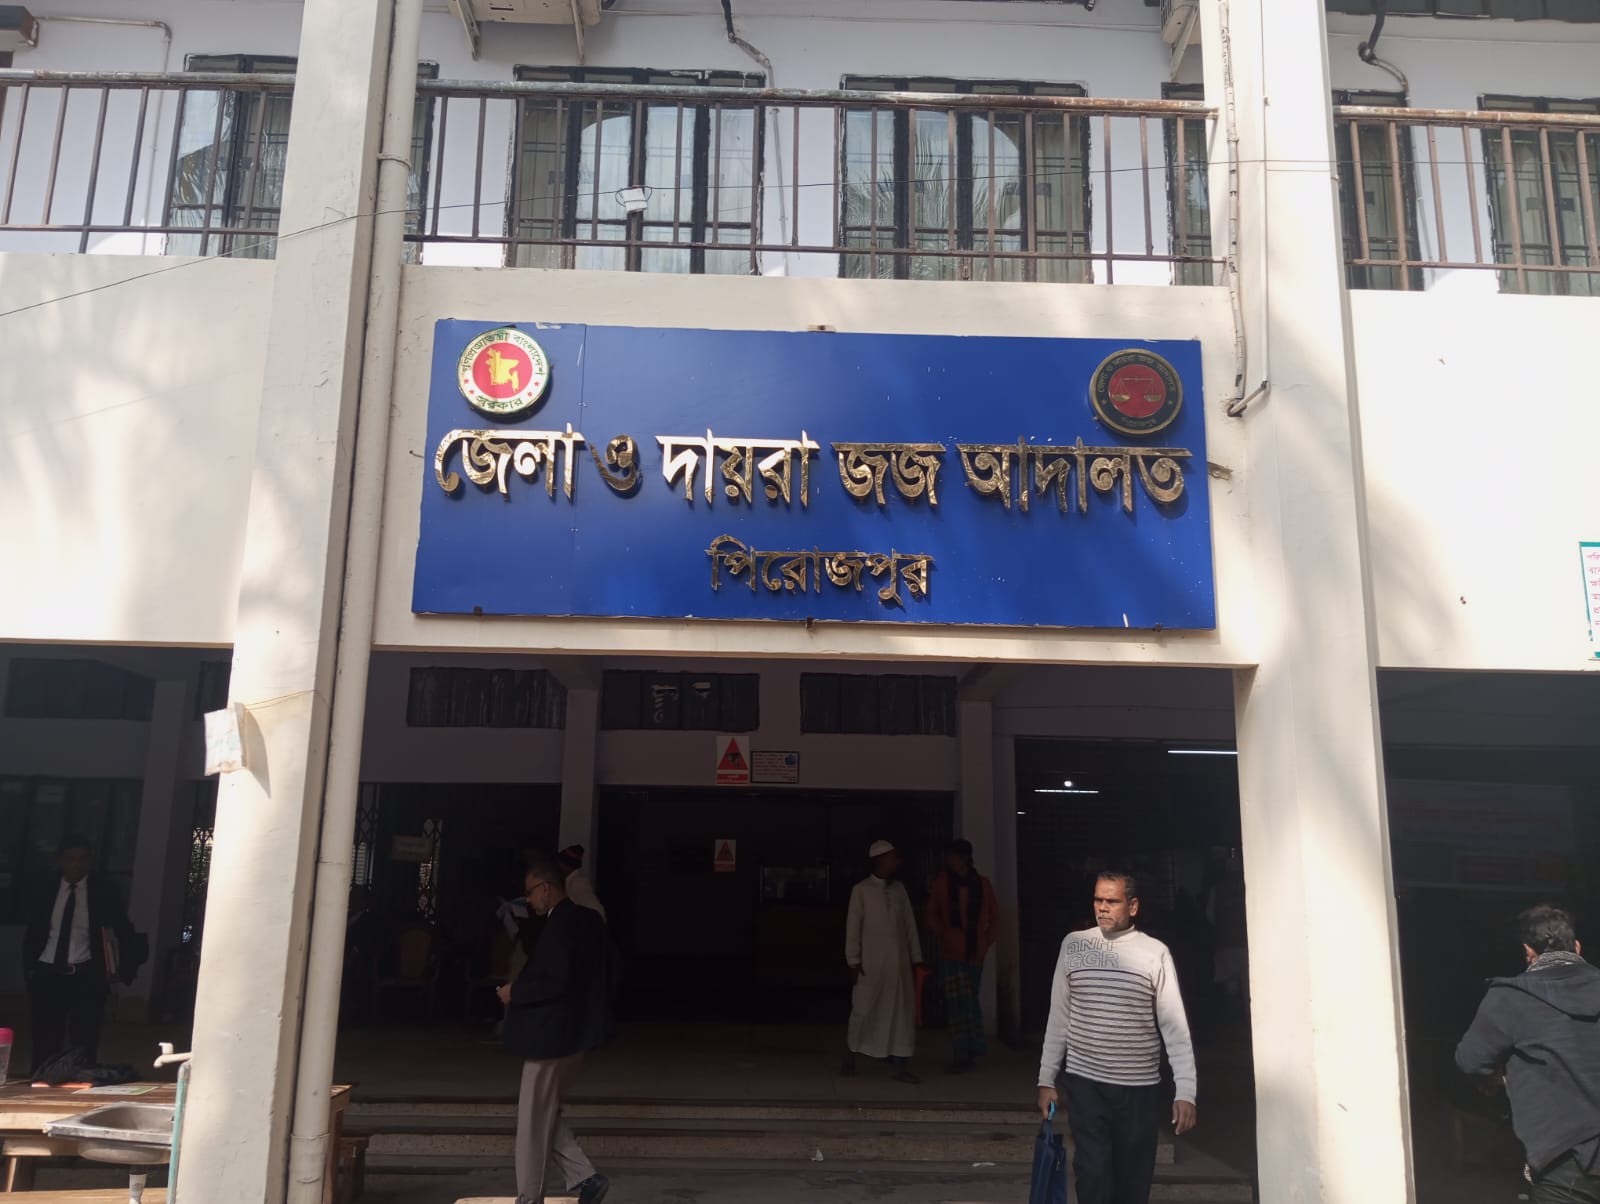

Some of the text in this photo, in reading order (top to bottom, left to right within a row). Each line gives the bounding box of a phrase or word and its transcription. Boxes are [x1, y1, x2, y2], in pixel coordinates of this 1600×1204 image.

[477, 395, 524, 410] সরকার
[434, 422, 1193, 512] জেলা ও দায়রা জজ আদালত
[704, 534, 935, 606] পিরোজপুর
